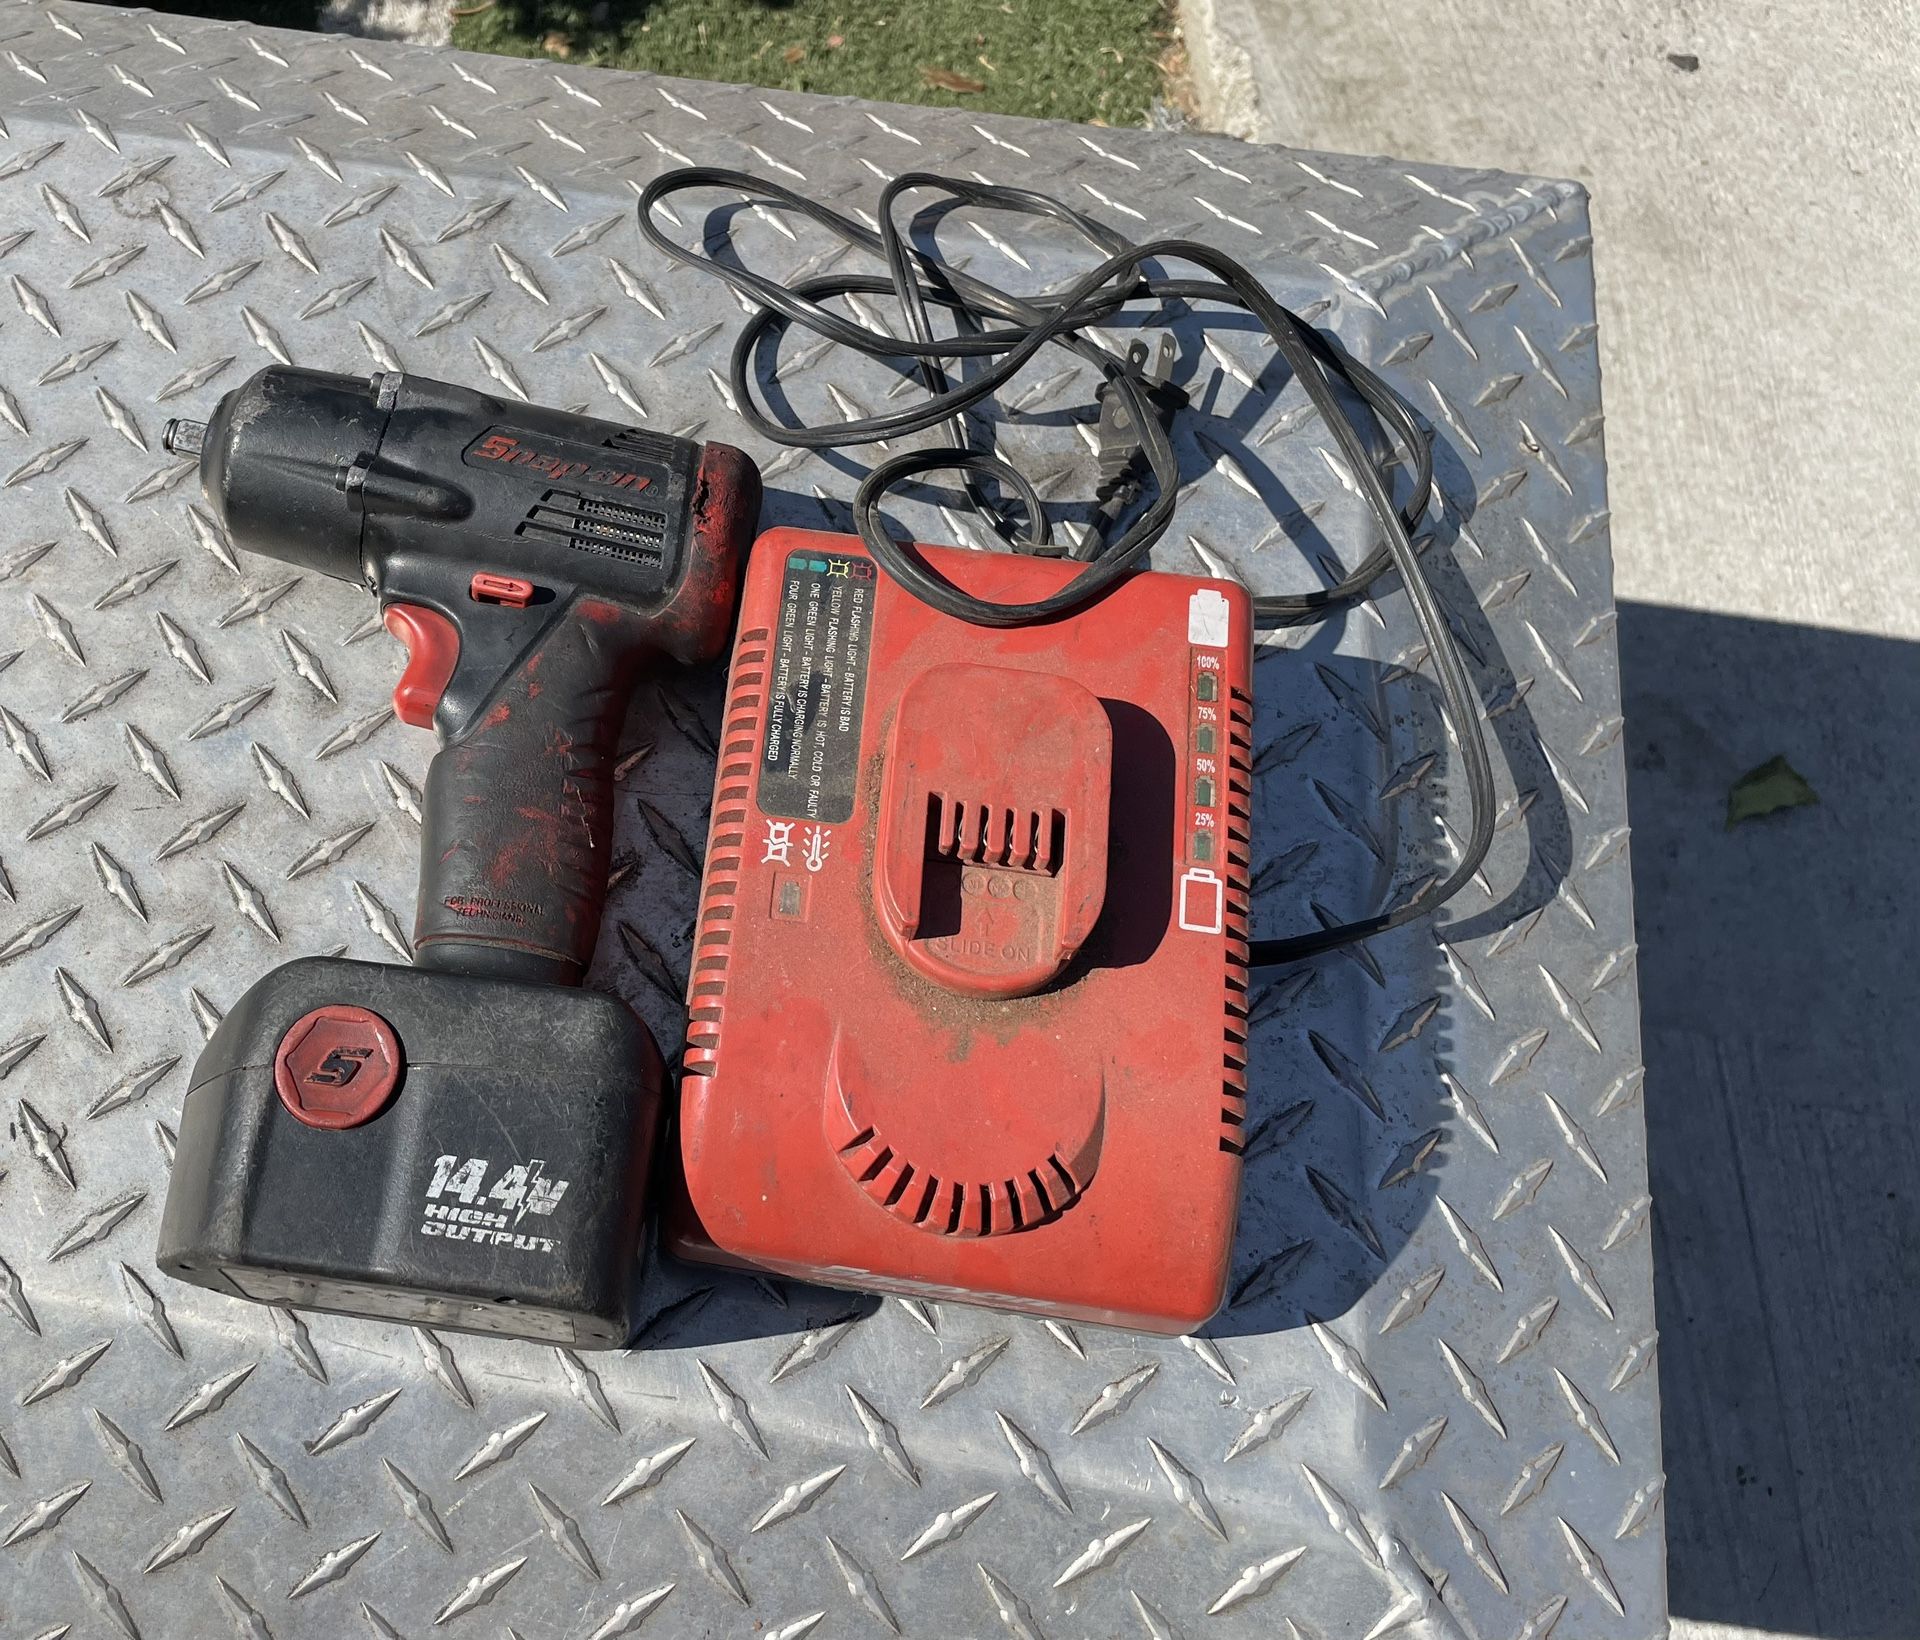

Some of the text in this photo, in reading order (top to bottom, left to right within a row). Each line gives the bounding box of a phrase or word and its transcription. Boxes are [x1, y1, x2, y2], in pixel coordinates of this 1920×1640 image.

[788, 580, 800, 600] FOUR
[809, 582, 821, 599] ONE
[830, 586, 843, 615] YELLOW
[852, 588, 865, 604] RED
[785, 602, 797, 627] GREEN
[806, 601, 819, 626] GREEN
[848, 606, 862, 642] FLASHING
[782, 630, 793, 652] LIGHT
[804, 628, 815, 650] LIGHT
[825, 617, 839, 653] FLASHING
[845, 644, 858, 666] LIGHT
[1196, 655, 1220, 670] 100%
[776, 658, 790, 692] BATTERY
[799, 656, 812, 690] BATTERY
[822, 655, 835, 678] LIGHT
[797, 690, 808, 698] IS
[818, 683, 832, 717] BATTERY
[841, 672, 855, 707] BATTERY
[772, 700, 785, 723] FULLY
[792, 698, 807, 737] CHARGING
[840, 707, 851, 715] IS
[1197, 707, 1217, 721] 75%
[816, 720, 827, 728] IS
[838, 716, 851, 732] BAD
[767, 724, 781, 760] CHARGED
[813, 730, 826, 748] HOT,
[788, 739, 802, 779] NORMALLY
[811, 751, 824, 772] COLD
[1196, 759, 1216, 772] 50%
[810, 775, 821, 786] OR
[807, 790, 819, 818] FAULTY
[1195, 812, 1215, 827] 25%
[444, 896, 464, 906] FOR
[935, 937, 1031, 962] SLIDE ON
[424, 1203, 508, 1229] HIGH
[421, 1220, 562, 1254] OUTPUT
